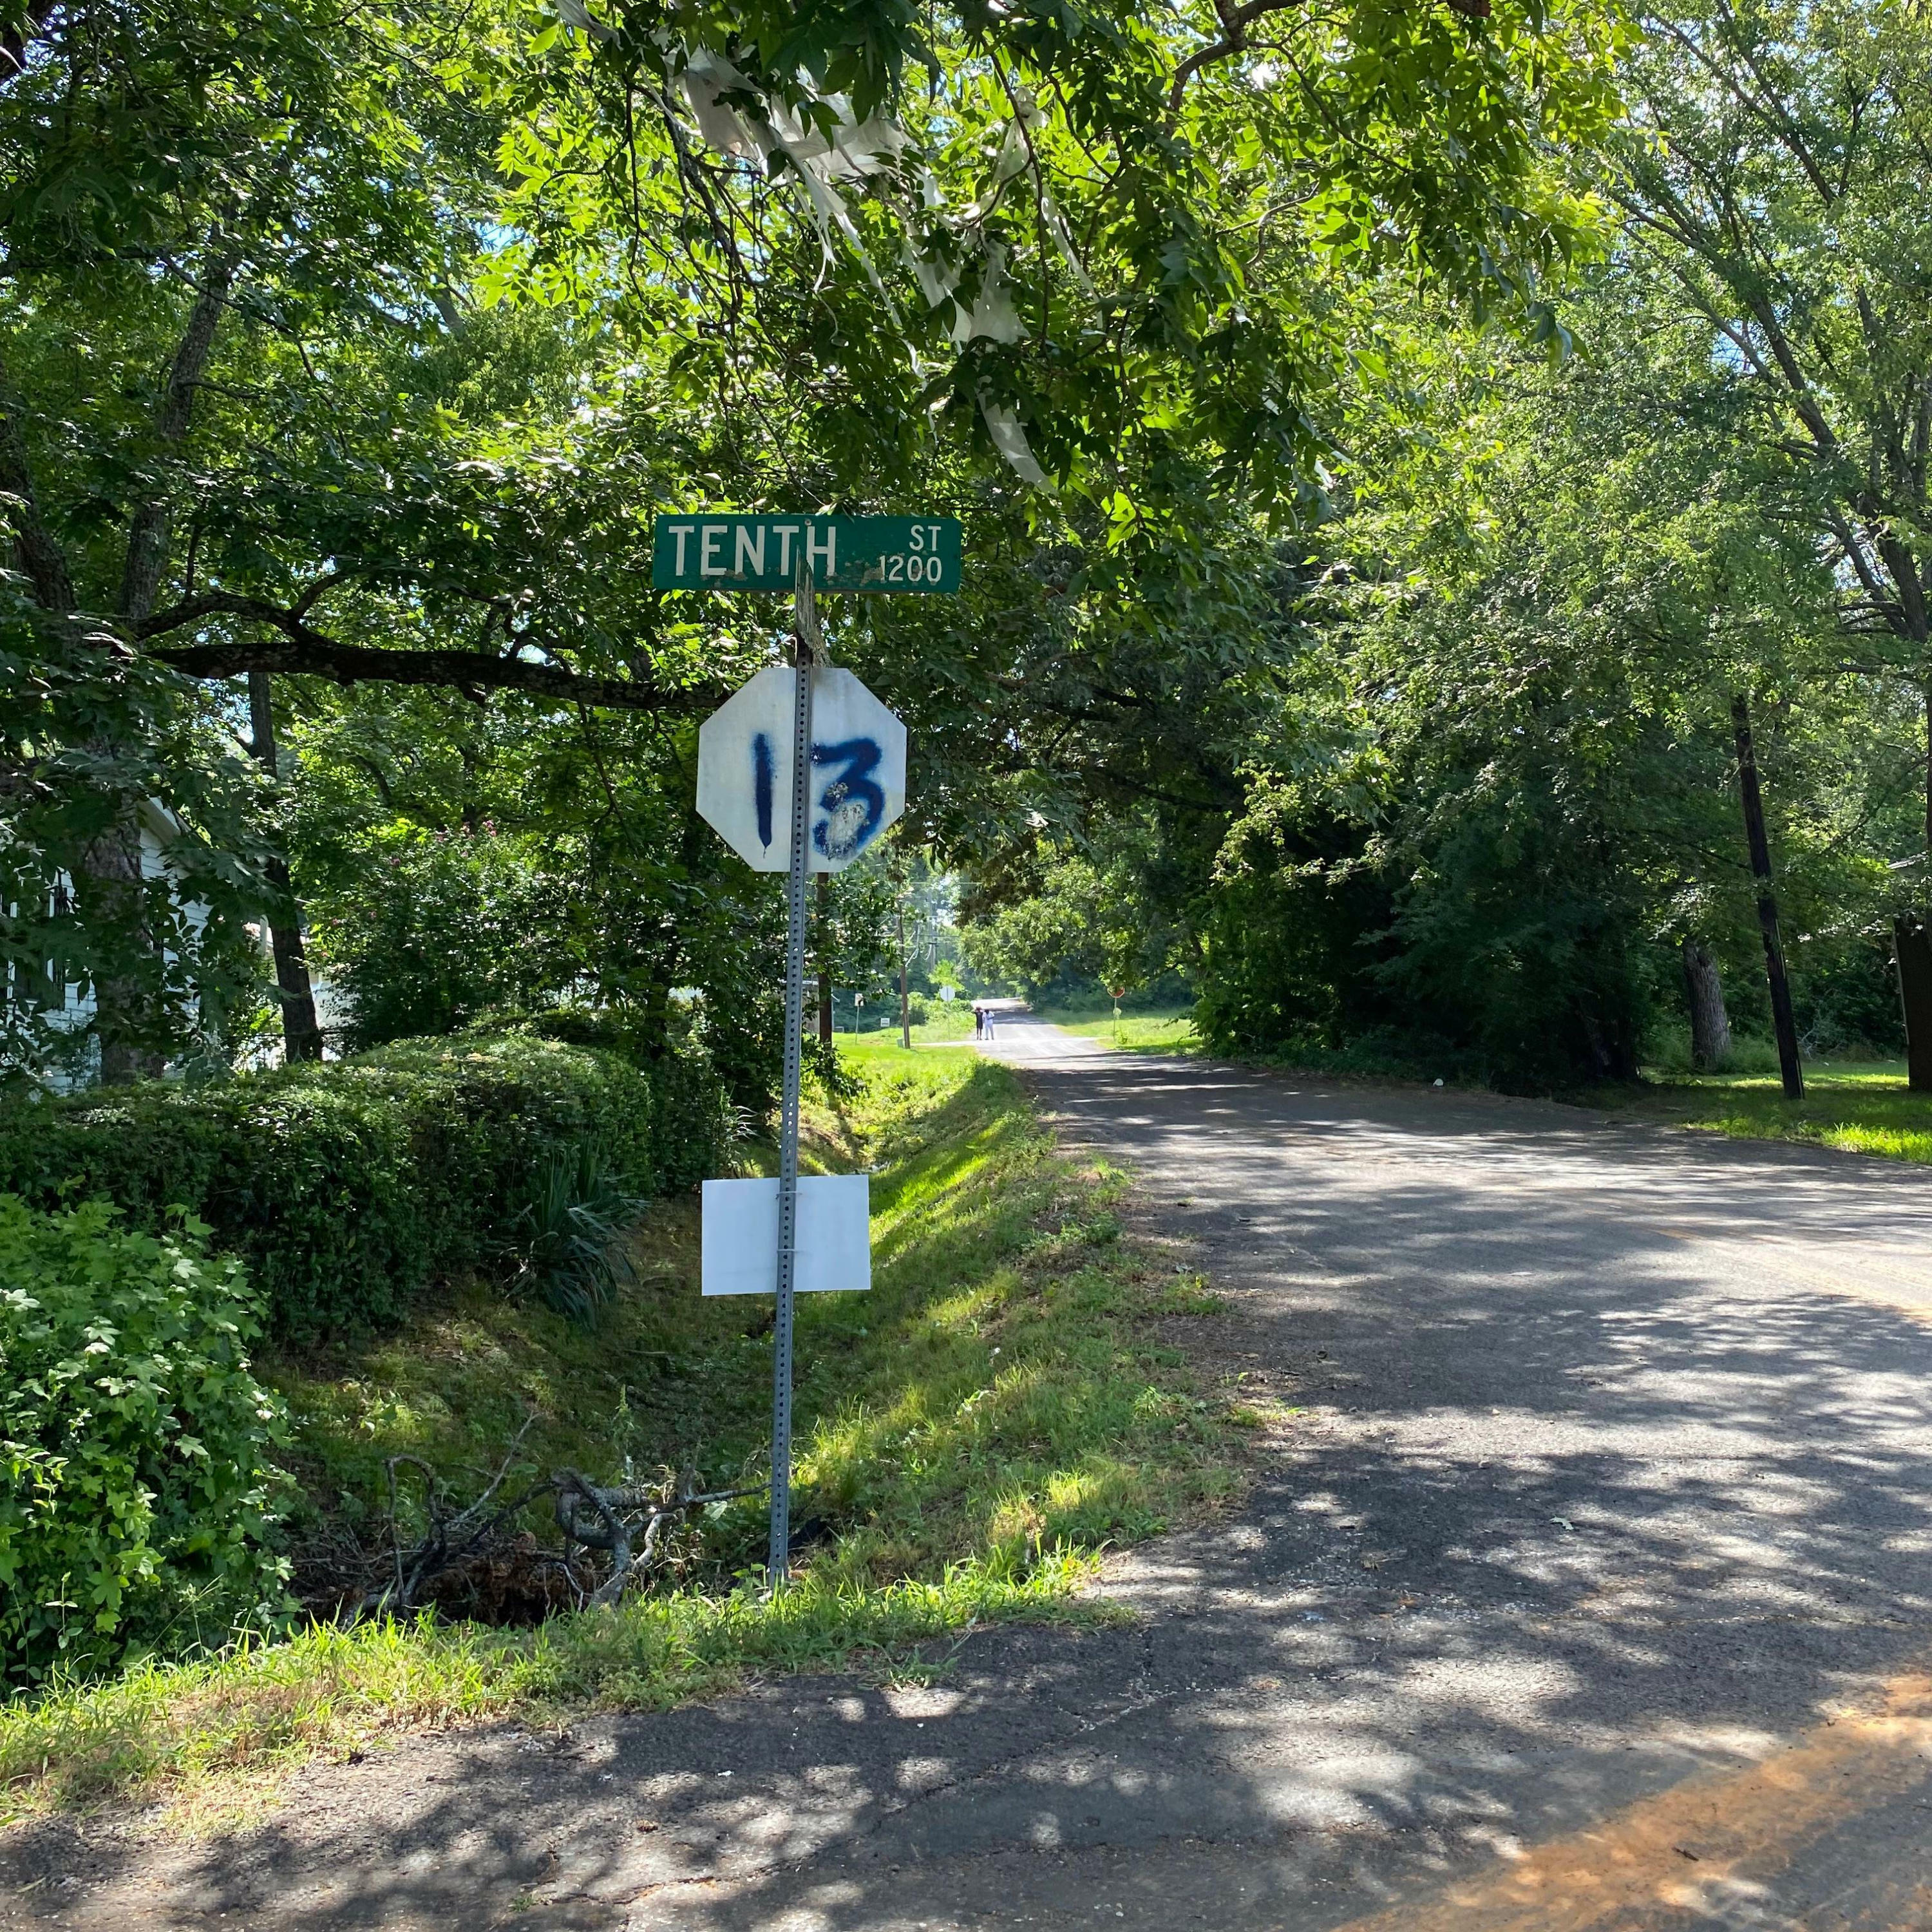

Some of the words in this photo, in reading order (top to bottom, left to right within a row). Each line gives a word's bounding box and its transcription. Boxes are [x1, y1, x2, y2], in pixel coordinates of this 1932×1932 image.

[668, 525, 837, 576] TENTH
[909, 524, 942, 551] ST
[879, 555, 942, 583] 1200
[752, 733, 884, 860] 13
